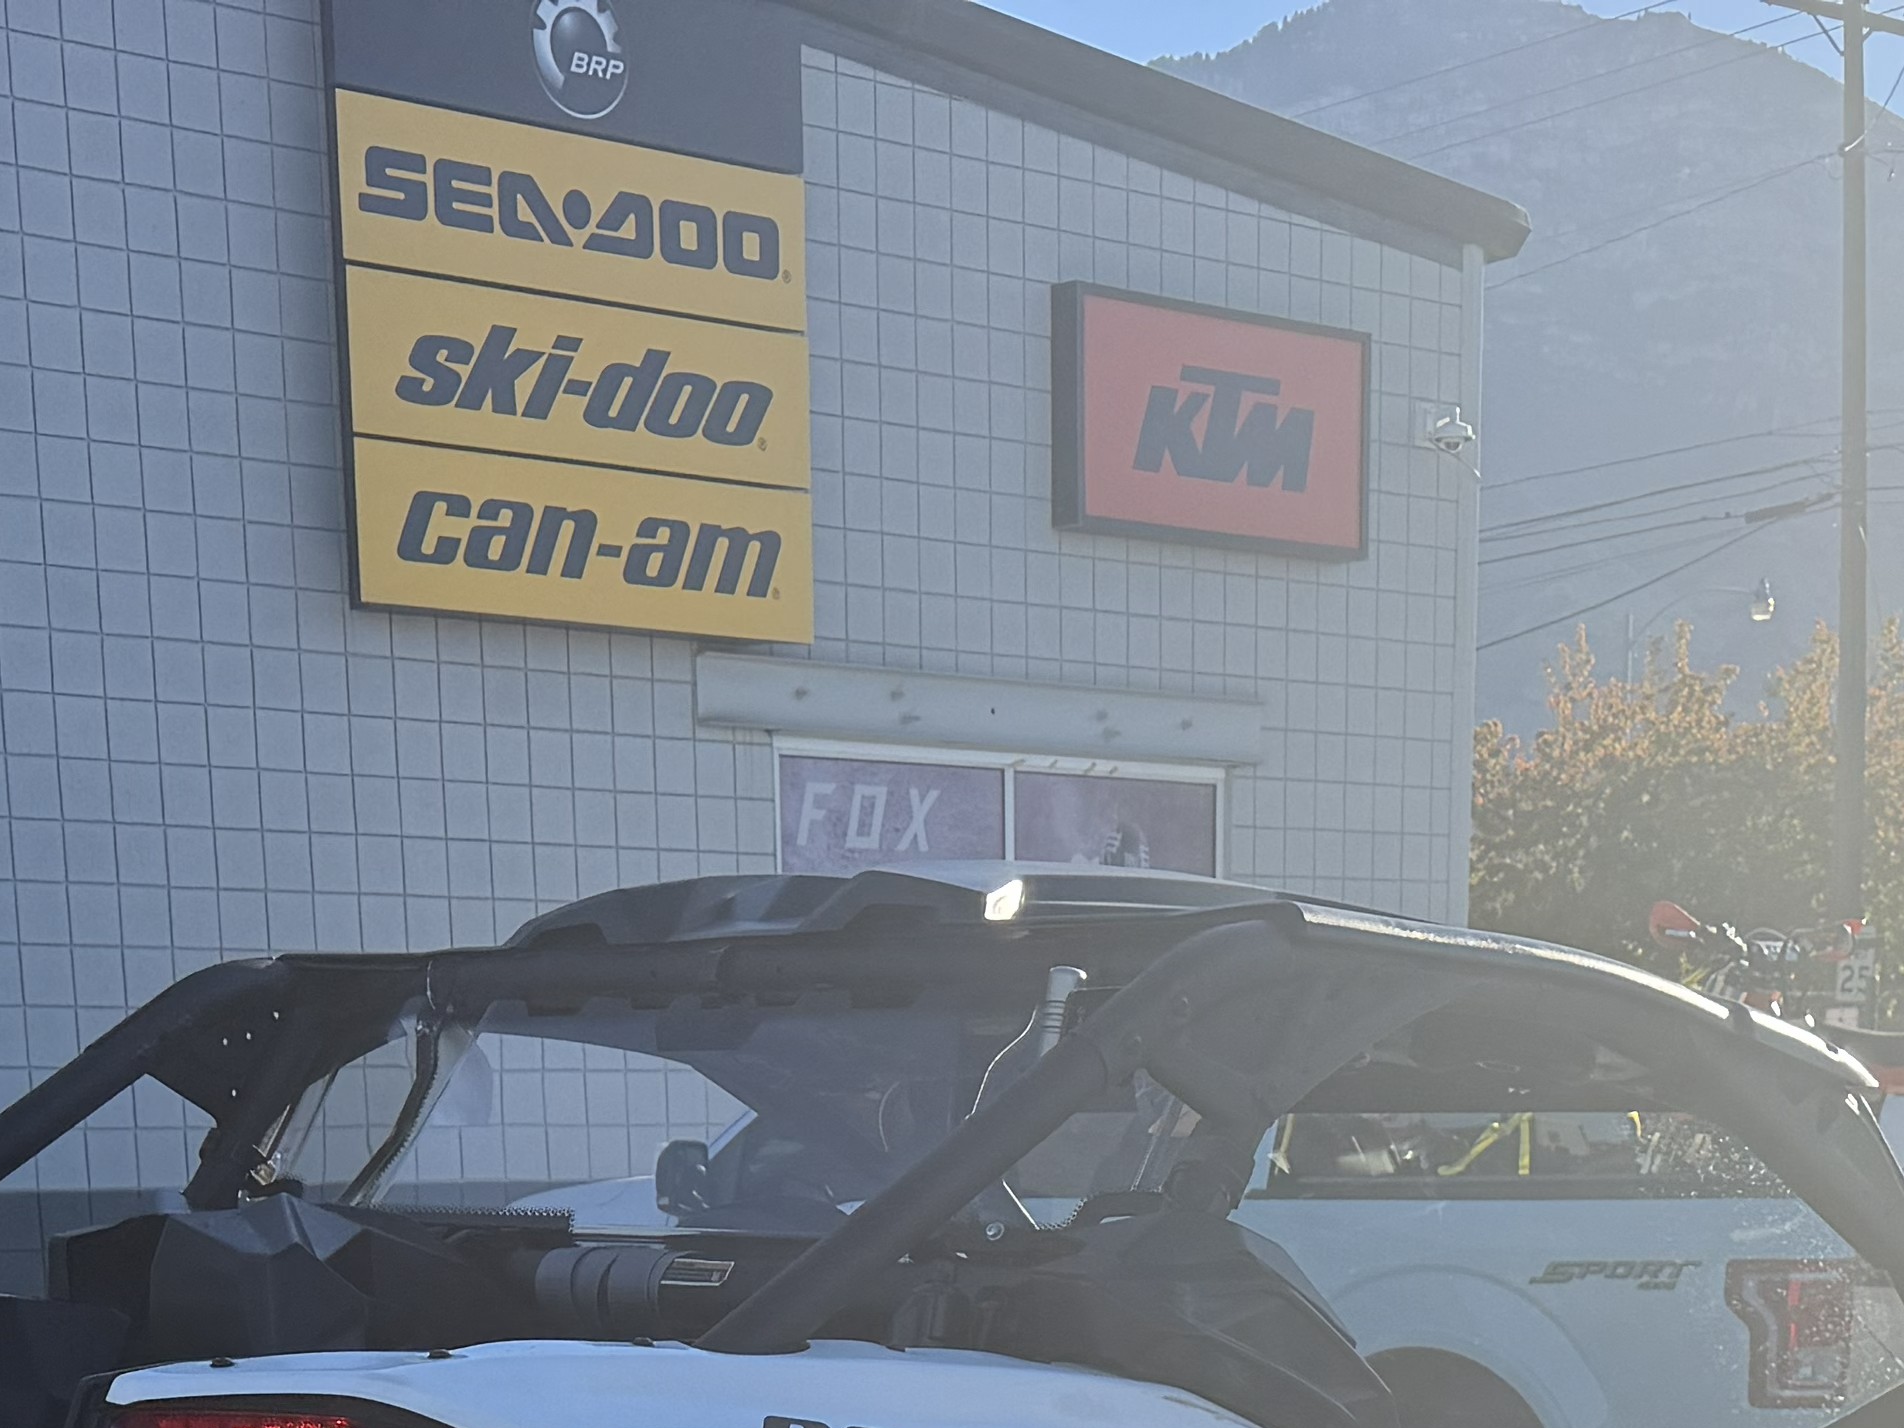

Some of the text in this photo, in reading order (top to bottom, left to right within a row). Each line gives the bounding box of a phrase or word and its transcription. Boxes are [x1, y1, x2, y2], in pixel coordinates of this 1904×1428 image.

[570, 51, 624, 80] BRP
[395, 324, 773, 446] ski-doo
[1132, 364, 1315, 493] KTM
[397, 490, 782, 598] can-am
[796, 782, 941, 852] FOX
[1840, 964, 1871, 994] 25
[1528, 1260, 1703, 1285] SPORT
